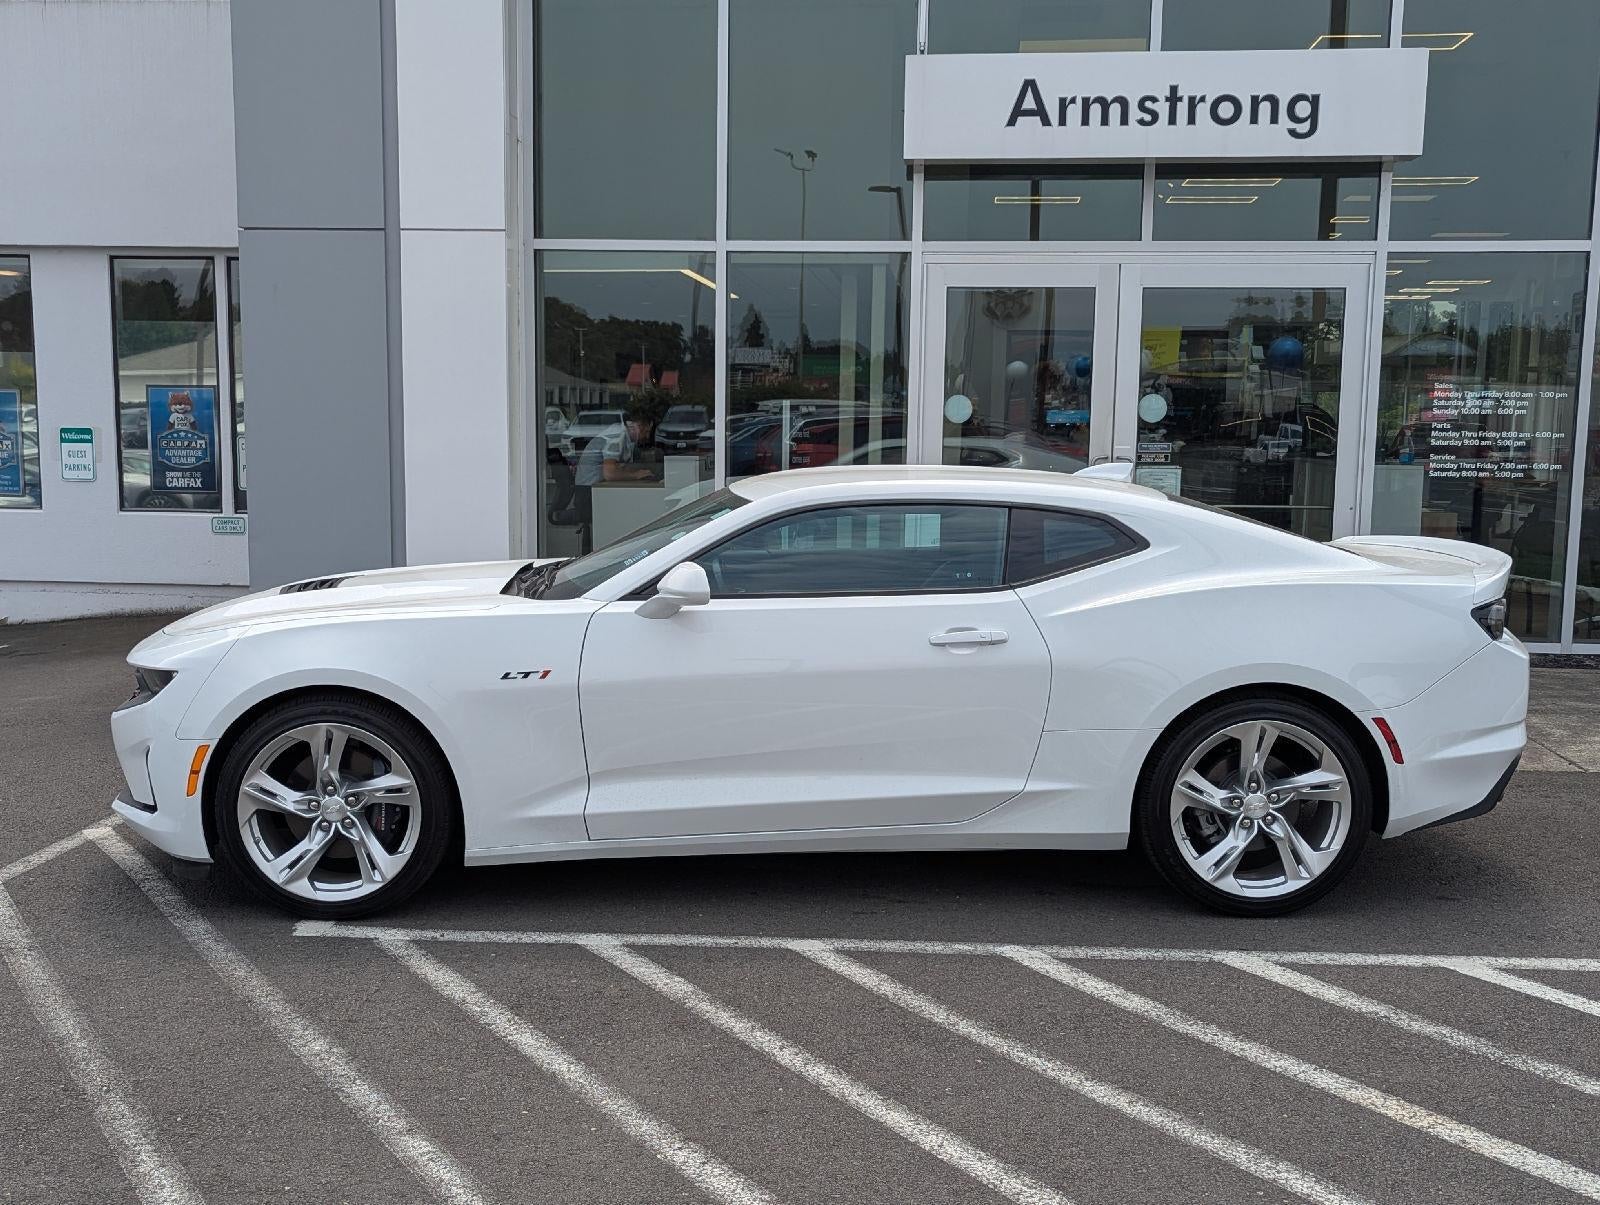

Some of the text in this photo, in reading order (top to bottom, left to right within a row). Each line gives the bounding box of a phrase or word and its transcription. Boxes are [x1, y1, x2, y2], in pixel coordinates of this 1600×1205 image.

[1004, 78, 1321, 139] Armstrong
[1481, 391, 1503, 399] Friday
[1432, 407, 1460, 416] Sunday
[1460, 407, 1480, 415] 10:00
[1514, 409, 1527, 417] pm
[61, 431, 92, 441] Welcome
[1431, 430, 1461, 439] Monday
[1461, 430, 1478, 438] Thru
[1478, 431, 1501, 440] Friday
[1552, 432, 1565, 440] pm
[162, 440, 205, 448] CARFAX
[1430, 438, 1463, 447] Saturday
[1513, 440, 1526, 448] pm
[67, 449, 87, 459] GUEST
[164, 449, 203, 457] ADVANTAGE
[1429, 453, 1456, 461] Service
[170, 456, 197, 464] DEALER
[64, 463, 92, 472] PARKING
[1429, 462, 1459, 470] Monday
[1476, 462, 1499, 471] Friday
[1499, 462, 1516, 470] 7:00
[1532, 462, 1549, 470] 6:00
[1428, 470, 1461, 479] Saturday
[1461, 470, 1477, 478] 8:00
[165, 477, 203, 488] CARFAX
[500, 669, 552, 680] LT1
